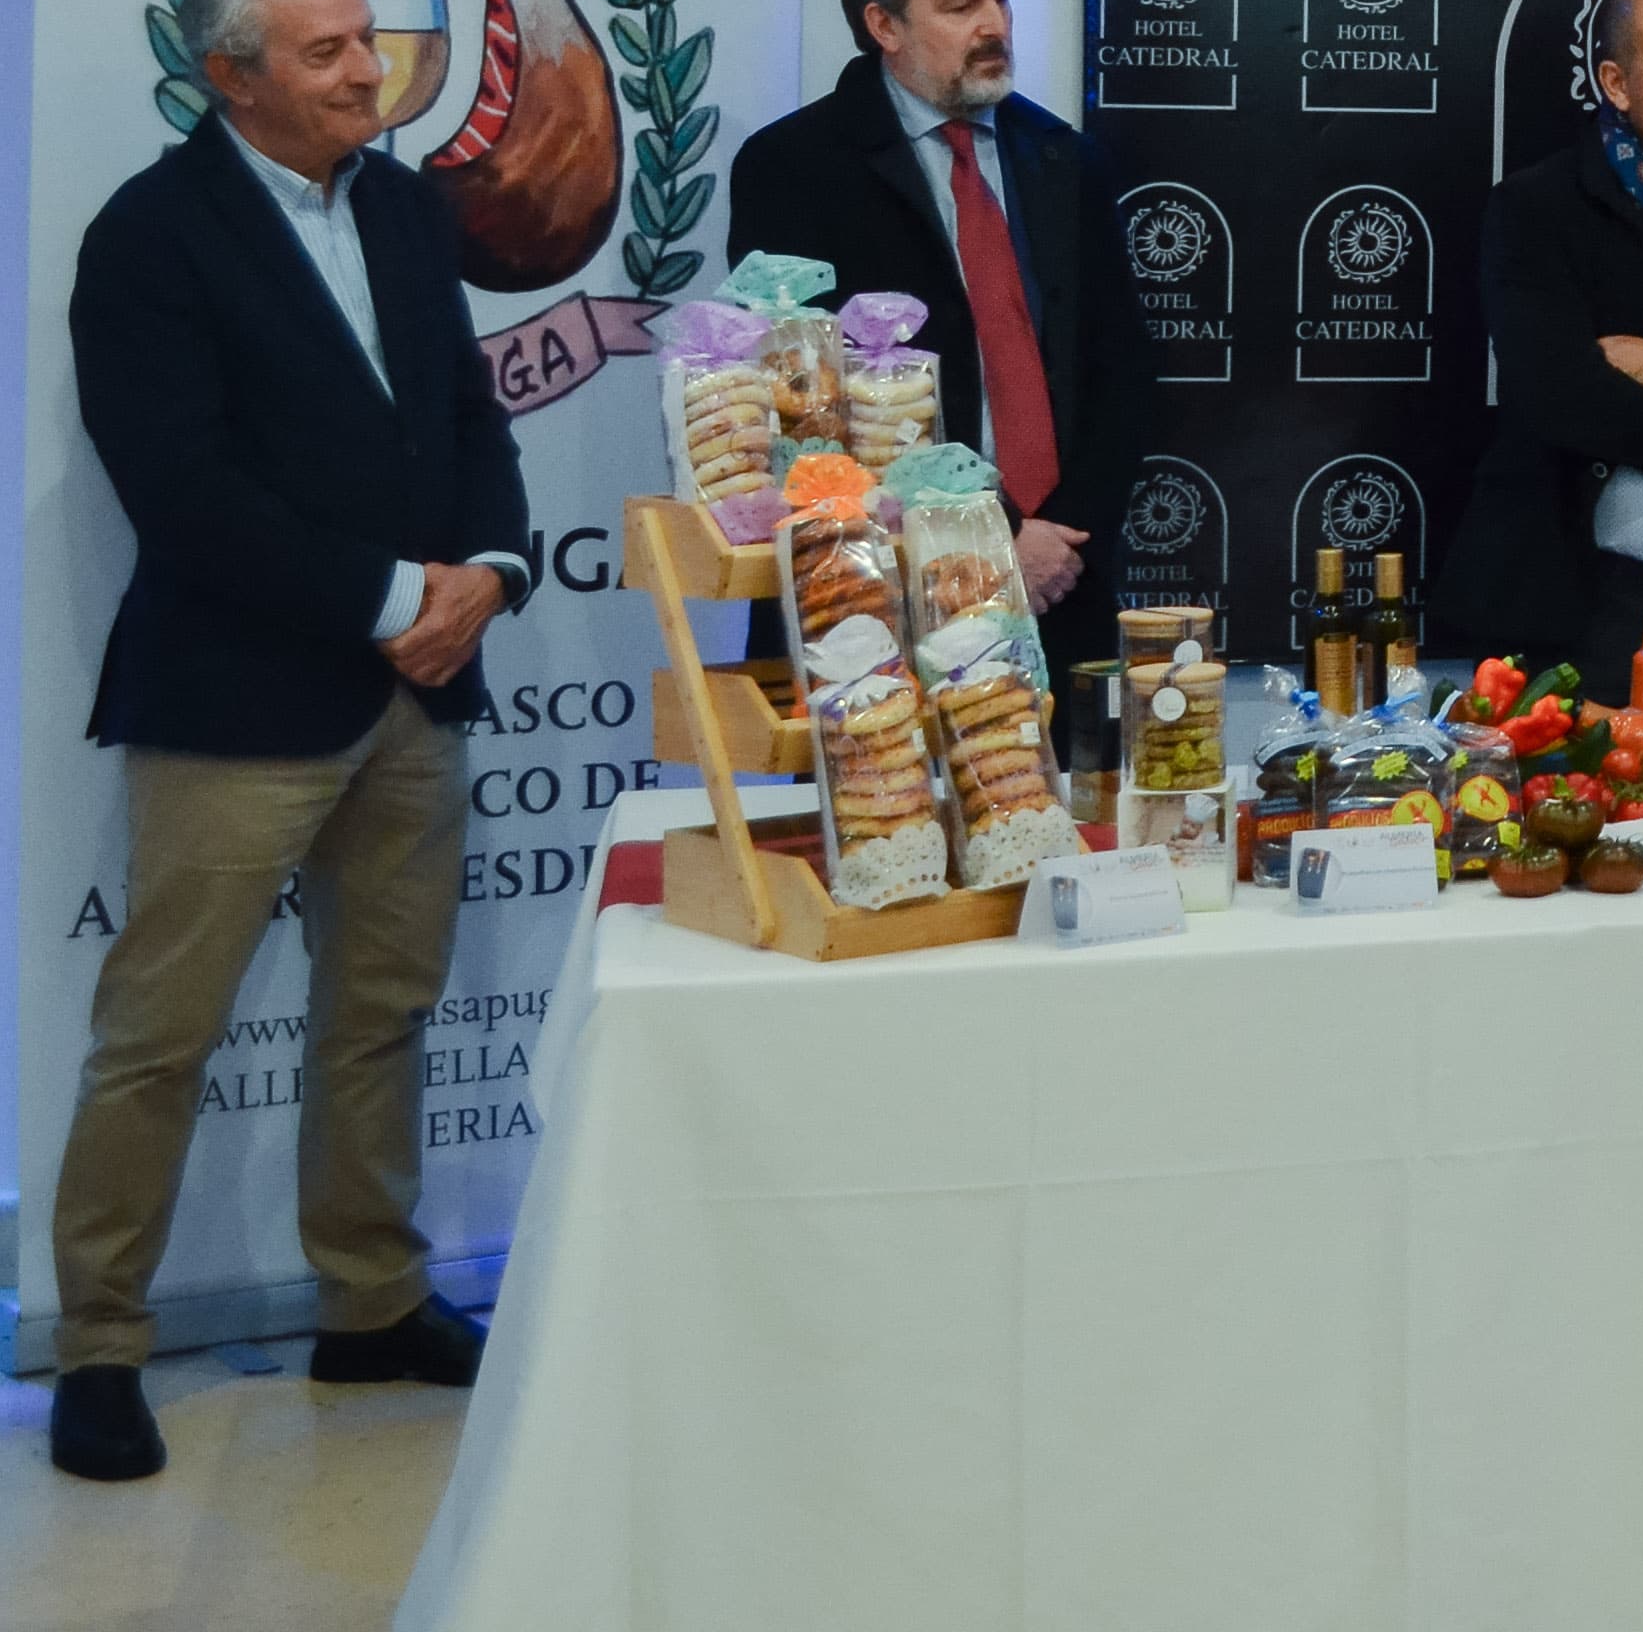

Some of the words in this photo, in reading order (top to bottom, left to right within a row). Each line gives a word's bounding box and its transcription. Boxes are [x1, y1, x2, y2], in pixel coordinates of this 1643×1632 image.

[1135, 20, 1203, 38] HOTEL
[1337, 24, 1406, 42] HOTEL
[1098, 45, 1239, 68] CATEDRAL
[1301, 48, 1439, 72] CATEDRAL
[1139, 293, 1199, 310] OTEL
[1332, 293, 1399, 310] HOTEL
[1146, 319, 1233, 340] EDRAL
[1295, 319, 1434, 341] CATEDRAL
[500, 327, 576, 401] GA
[1127, 565, 1195, 582] HOTEL
[1117, 590, 1230, 610] ATEDRAL
[466, 680, 636, 736] ASCO
[471, 765, 561, 818] CO
[424, 1041, 530, 1088] ELLA
[426, 1101, 536, 1148] ERIA
